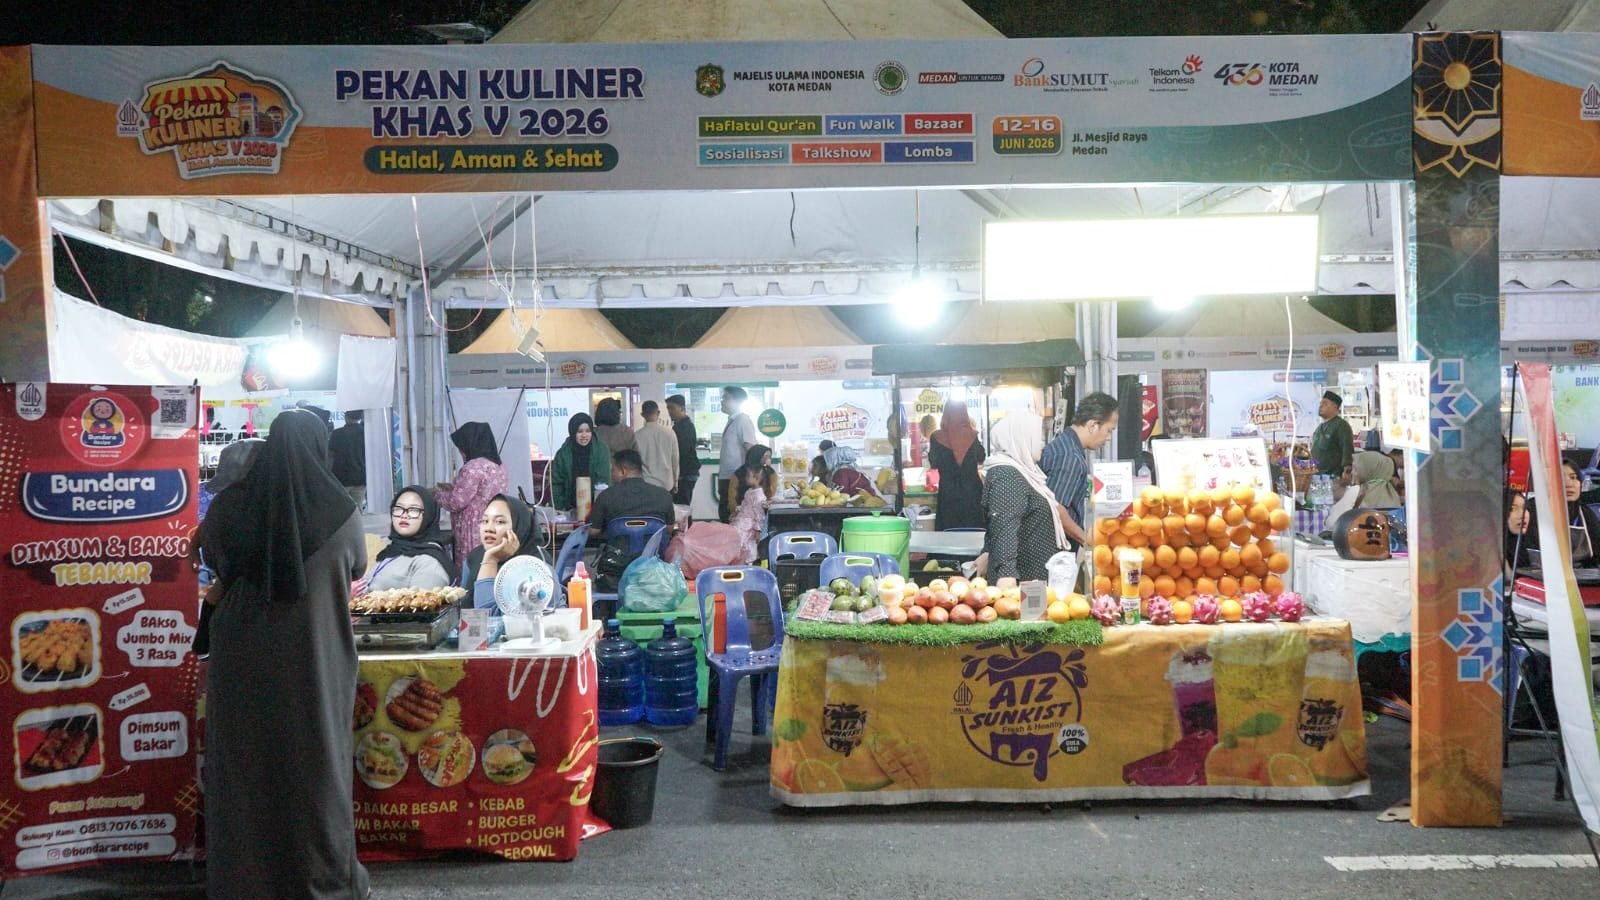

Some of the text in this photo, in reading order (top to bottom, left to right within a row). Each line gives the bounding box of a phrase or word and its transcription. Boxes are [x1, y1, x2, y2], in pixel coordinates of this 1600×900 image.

[1149, 68, 1180, 76] Telkom
[1269, 63, 1300, 73] KOTA
[733, 70, 865, 80] MAJELIS ULAMA INDONESIA
[919, 74, 956, 83] MEDAN
[1014, 73, 1109, 87] BankSUMUT
[1153, 76, 1195, 85] Indonesia
[1269, 74, 1319, 85] MEDAN
[335, 67, 645, 101] PEKAN KULINER
[769, 82, 832, 92] KOTA MEDAN
[154, 101, 224, 126] Pekan
[372, 105, 609, 138] KHAS V 2026
[704, 119, 816, 132] Haflatul Qur'an
[830, 119, 895, 130] Fun Walk
[914, 118, 964, 129] Bazaar
[1000, 119, 1055, 132] 12-16
[143, 117, 242, 150] KULINER
[1072, 131, 1148, 143] Jl. Mesjid Raya
[1000, 138, 1055, 149] JUNI 2026
[1072, 145, 1108, 155] Medan
[177, 141, 278, 162] KHAS V 2026
[705, 147, 783, 160] Sosialisasi
[802, 147, 871, 159] Talkshow
[905, 145, 953, 157] Lomba
[380, 148, 603, 171] Halal, Aman & Sehat
[527, 407, 569, 417] NDONESIA
[916, 403, 944, 413] OPEN
[51, 472, 156, 494] Bundara
[72, 495, 136, 514] Recipe
[12, 535, 191, 566] DIMSUM & BAKSO
[51, 562, 152, 587] TEBAKAR
[123, 632, 192, 645] Jumbo Mix
[136, 648, 177, 660] 3 Rasa
[989, 677, 1058, 710] AIZ
[969, 702, 1073, 731] SUNKIST
[127, 720, 180, 735] Dimsum
[1002, 726, 1024, 734] Fresh
[1034, 721, 1063, 731] Healthy
[1062, 729, 1085, 738] 100%
[133, 738, 176, 753] Bakar
[364, 802, 408, 815] BAKAR
[411, 800, 458, 815] BESAR
[480, 798, 525, 812] KEBAB
[79, 819, 167, 834] 0813.7076.7636
[374, 819, 420, 831] BAKAR
[479, 814, 536, 829] BURGER
[478, 826, 565, 847] HOTDOUGH
[62, 841, 150, 858] @bundararecipe
